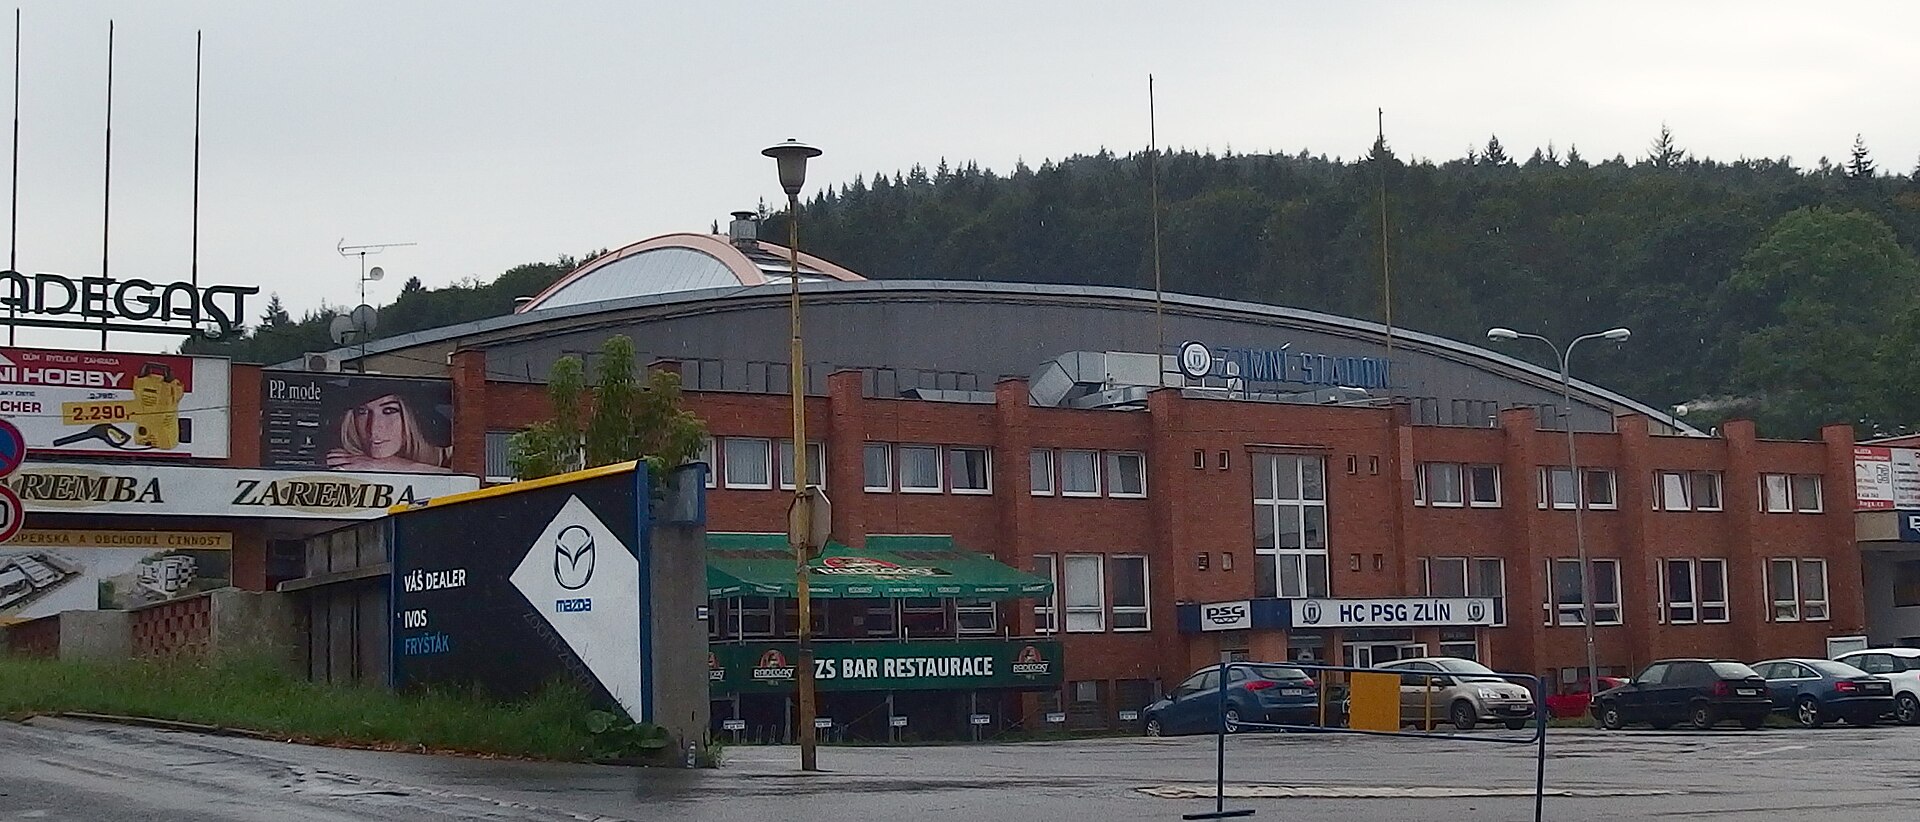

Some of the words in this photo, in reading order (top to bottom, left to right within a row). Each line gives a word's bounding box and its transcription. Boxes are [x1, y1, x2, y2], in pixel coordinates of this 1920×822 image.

[46, 354, 79, 363] BYDLENÍ
[84, 357, 120, 366] ZAHRADA
[23, 367, 125, 387] HOBBY
[289, 381, 322, 400] mode
[0, 400, 42, 413] CHER
[73, 405, 136, 421] 2.290,-
[0, 473, 165, 504] REMBA
[231, 479, 416, 509] ZAREMBA
[95, 533, 158, 545] OBCHODNÍ
[167, 532, 222, 546] ČINNOST
[404, 569, 424, 592] VÁŠ
[425, 569, 466, 590] DEALER
[404, 609, 427, 628] IVOS
[1340, 604, 1366, 623] HC
[1371, 603, 1407, 622] PSG
[1413, 599, 1451, 622] ZLÍN
[404, 633, 449, 655] FRYŠTÁK
[814, 659, 836, 679] ZS
[842, 658, 878, 679] BAR
[884, 656, 993, 678] RESTAURACE
